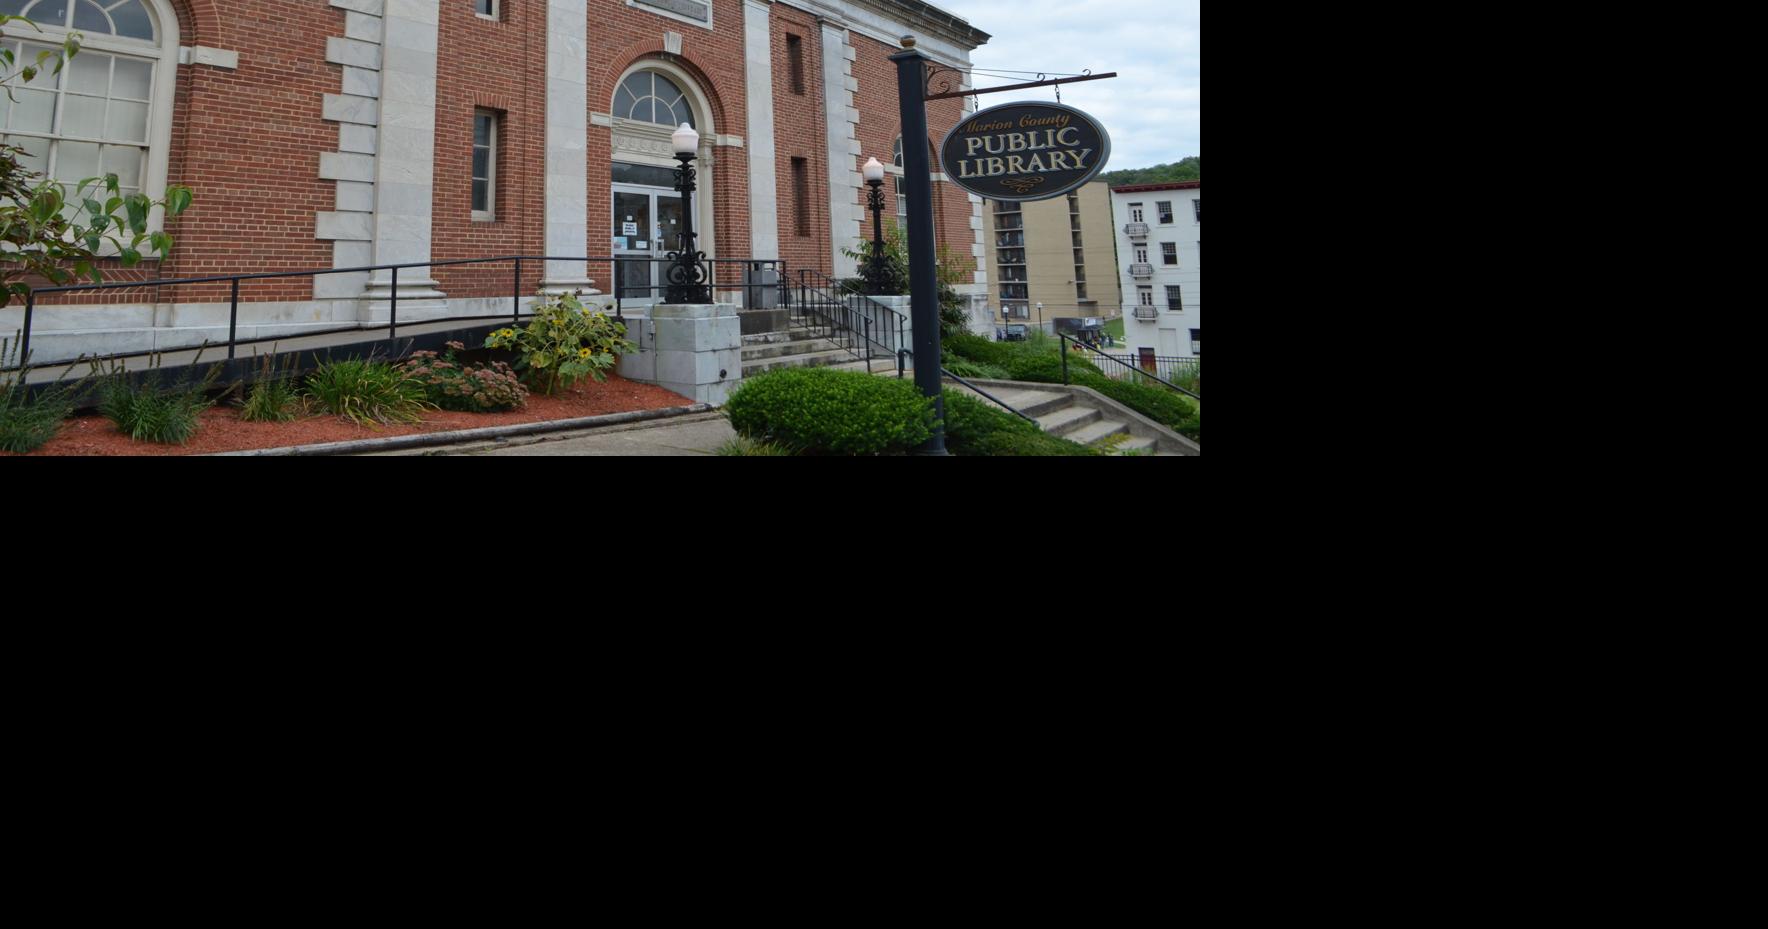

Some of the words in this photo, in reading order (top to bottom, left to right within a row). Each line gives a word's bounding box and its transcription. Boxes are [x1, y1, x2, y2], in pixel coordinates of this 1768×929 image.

[962, 119, 1013, 133] Marion
[1018, 114, 1071, 128] County
[964, 127, 1081, 157] PUBLIC
[957, 148, 1093, 179] LIBRARY
